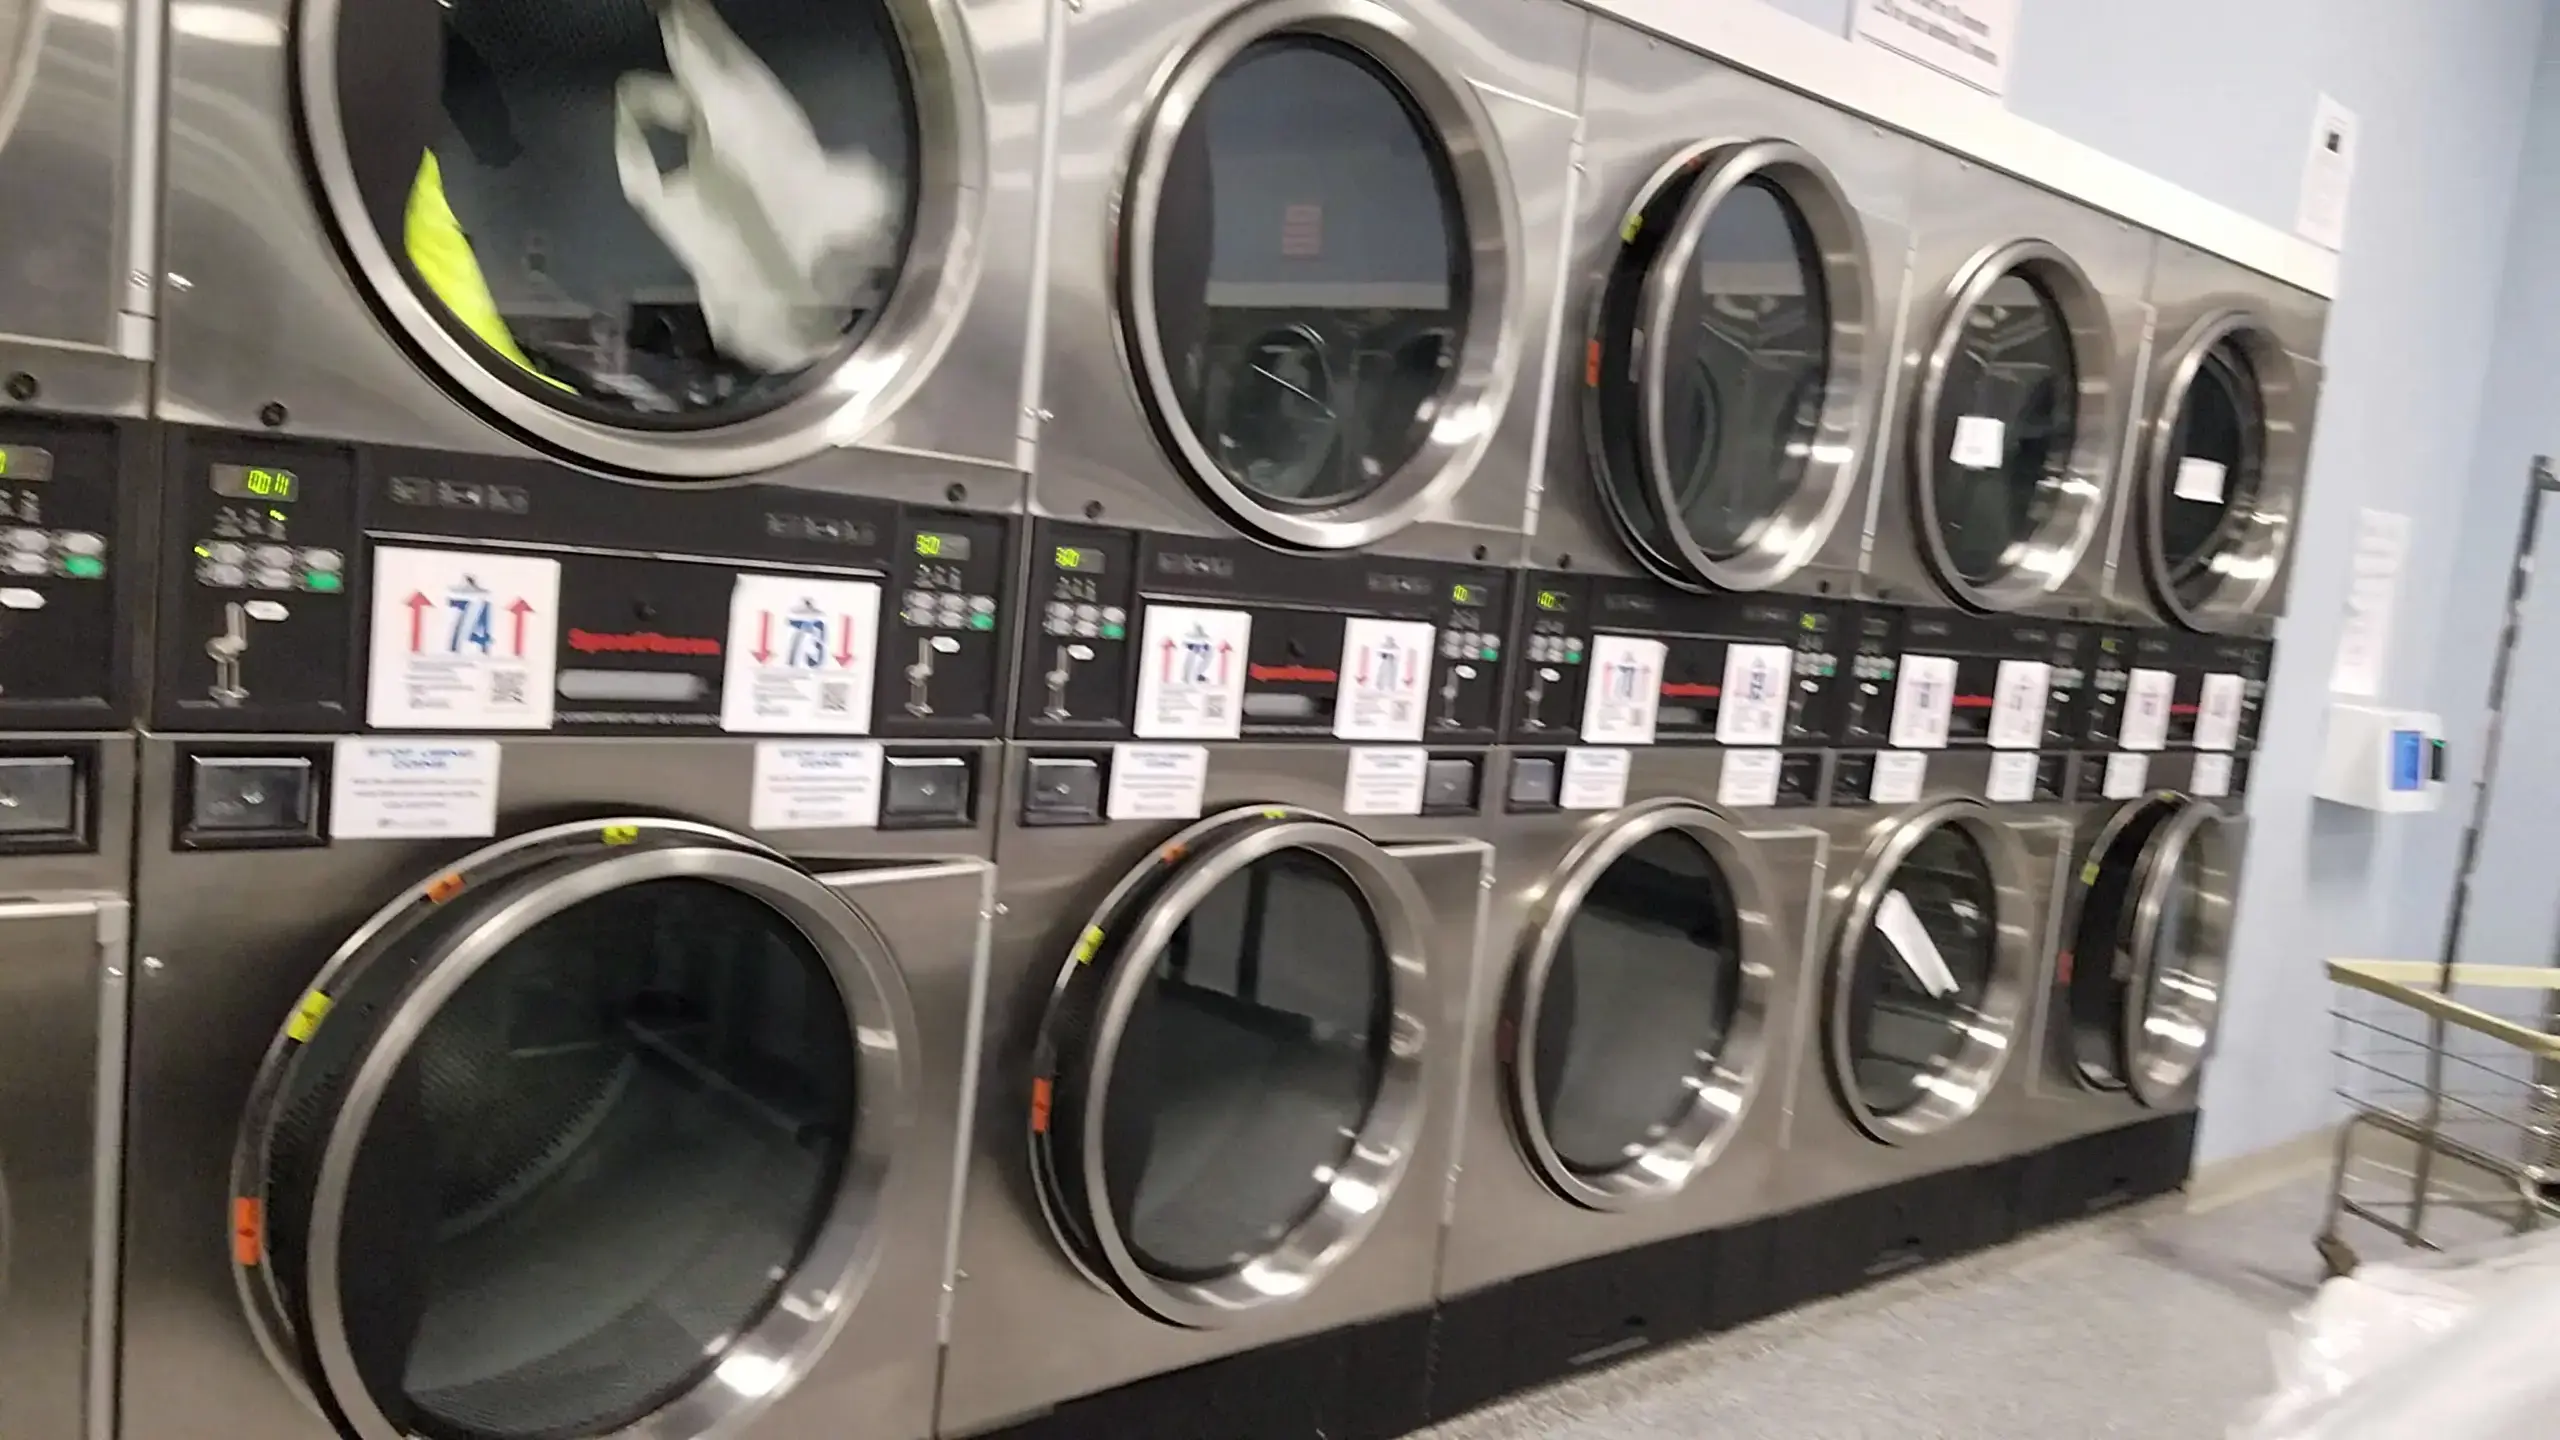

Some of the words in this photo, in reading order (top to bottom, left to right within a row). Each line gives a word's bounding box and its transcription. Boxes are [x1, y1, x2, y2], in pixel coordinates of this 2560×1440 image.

[448, 597, 494, 653] 74
[786, 618, 826, 668] 73
[1183, 641, 1214, 684] 72
